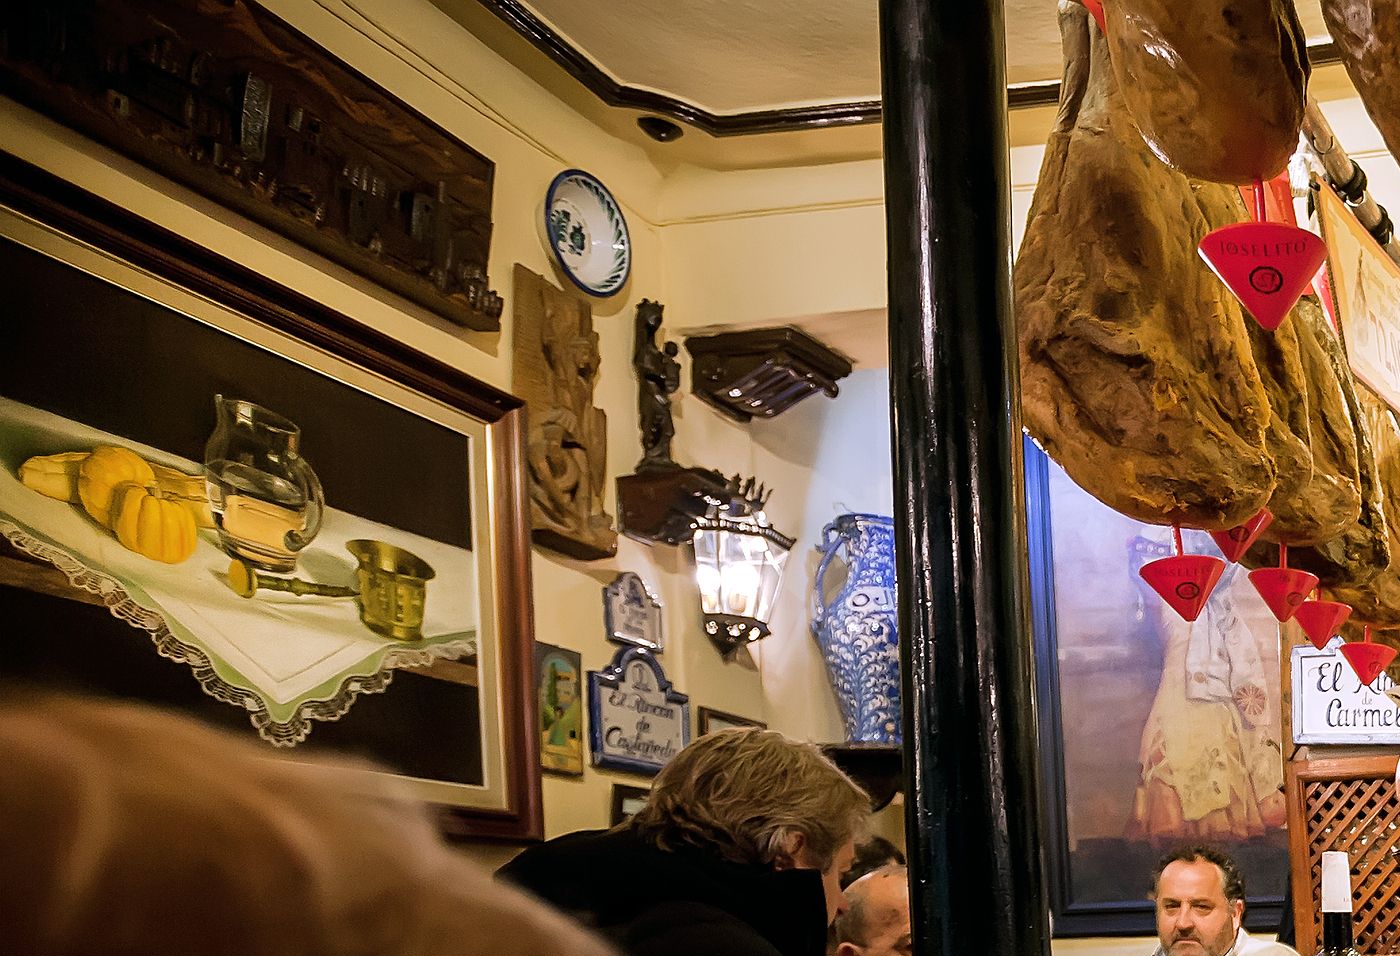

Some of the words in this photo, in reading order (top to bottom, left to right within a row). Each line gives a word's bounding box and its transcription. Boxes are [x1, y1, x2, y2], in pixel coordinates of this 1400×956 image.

[1219, 239, 1306, 257] JOSELITO
[1309, 662, 1344, 692] El
[1361, 691, 1373, 705] de
